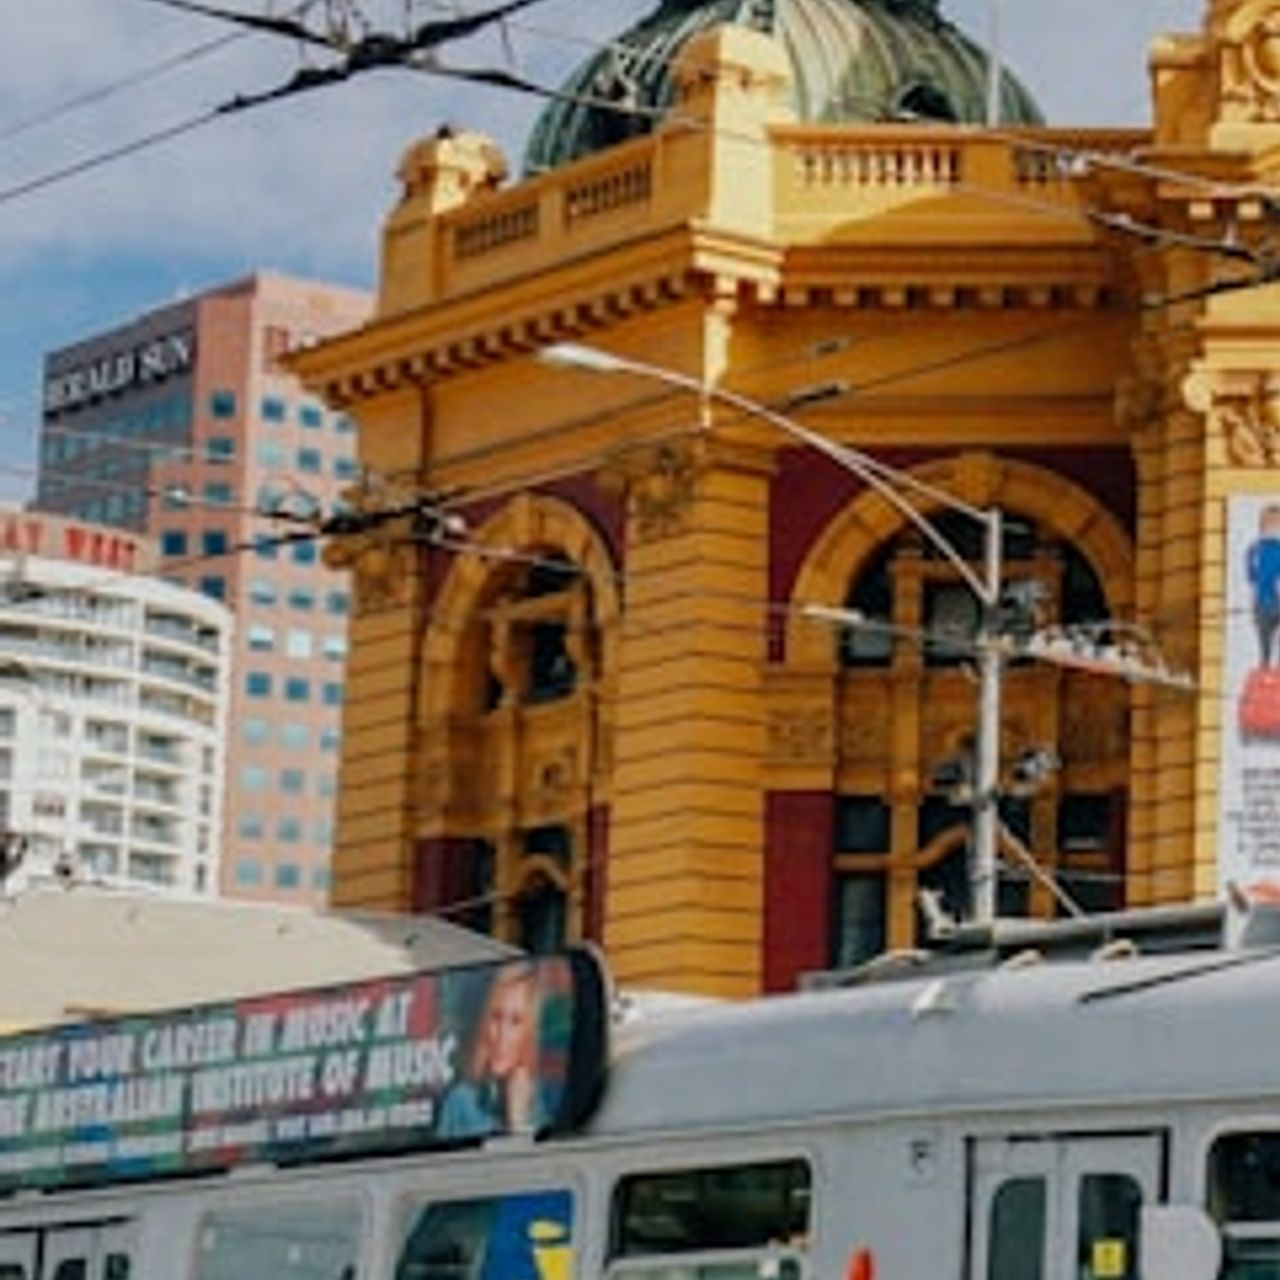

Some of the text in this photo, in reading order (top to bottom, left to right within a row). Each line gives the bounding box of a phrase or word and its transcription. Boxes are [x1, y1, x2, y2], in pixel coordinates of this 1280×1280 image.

[142, 1016, 235, 1070] CAREER
[276, 990, 367, 1052] MUSIC
[374, 988, 412, 1037] AT
[191, 1054, 316, 1118] INSTITUTE
[321, 1050, 360, 1098] OF
[364, 1034, 456, 1090] MUSIC
